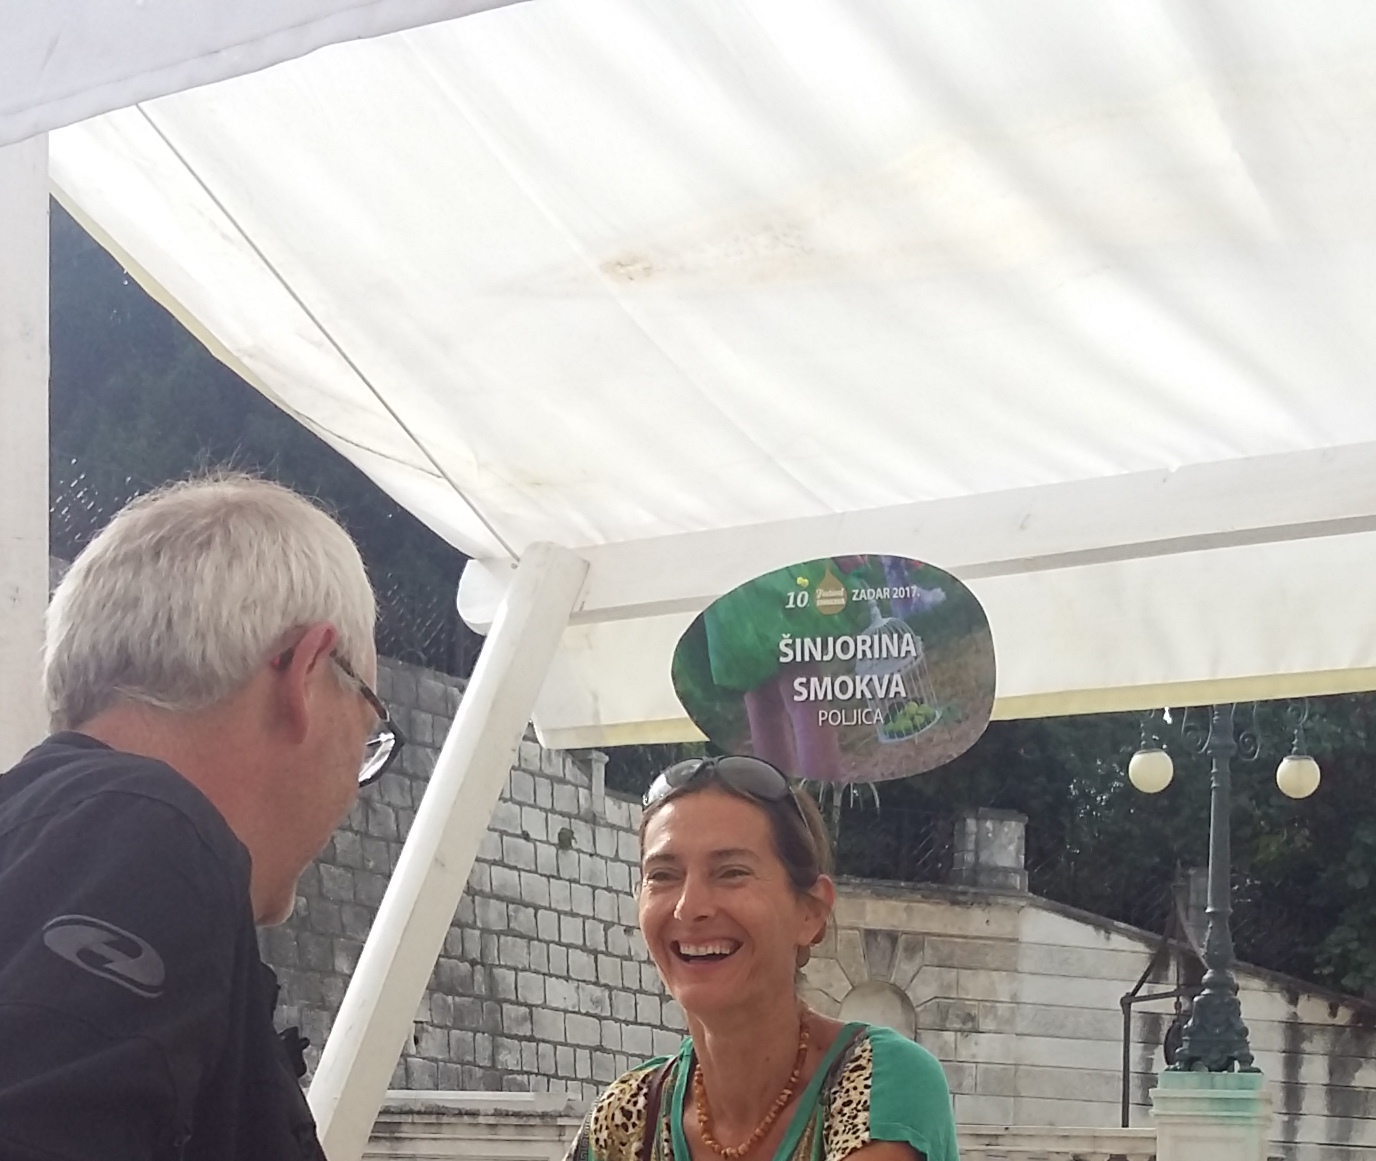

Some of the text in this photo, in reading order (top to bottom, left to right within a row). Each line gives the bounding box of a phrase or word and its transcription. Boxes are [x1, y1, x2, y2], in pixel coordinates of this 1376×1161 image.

[852, 585, 921, 601] ZADAR 2017.
[779, 633, 917, 664] ŠINJORINA
[793, 674, 907, 702] SMOKVA
[819, 708, 884, 726] POLJICA
